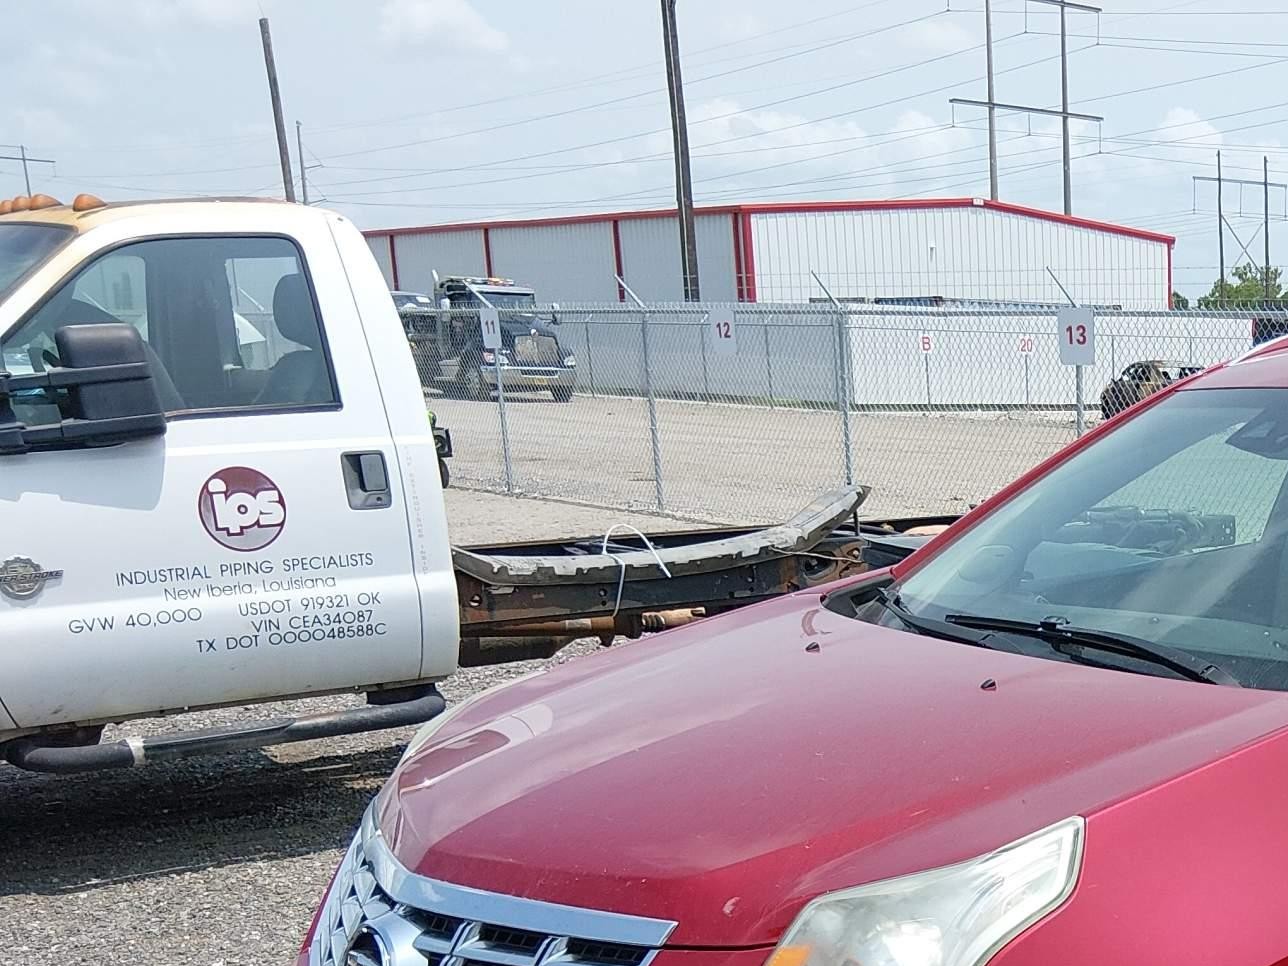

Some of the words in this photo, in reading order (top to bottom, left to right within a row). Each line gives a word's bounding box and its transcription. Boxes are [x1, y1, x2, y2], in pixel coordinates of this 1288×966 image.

[485, 320, 496, 335] 11
[716, 322, 731, 338] 12
[1066, 325, 1087, 345] 13
[921, 336, 932, 351] B
[1020, 338, 1033, 352] 20
[207, 478, 286, 536] ips
[116, 565, 212, 587] INDUSTRIAL
[220, 560, 274, 577] PIPING
[282, 552, 374, 572] SPECIALISTS
[164, 587, 201, 602] New
[206, 582, 258, 598] Iberia,
[262, 576, 337, 593] Louisiana
[239, 599, 291, 617] USDOT
[300, 593, 349, 611] 919321
[357, 591, 382, 606] OK
[68, 615, 115, 634] GVW
[125, 607, 202, 628] 40,000
[250, 618, 281, 633] VIN
[288, 610, 373, 630] CEA34087
[196, 639, 217, 653] TX
[226, 634, 260, 650] DOT
[268, 622, 388, 646] 000048588C
